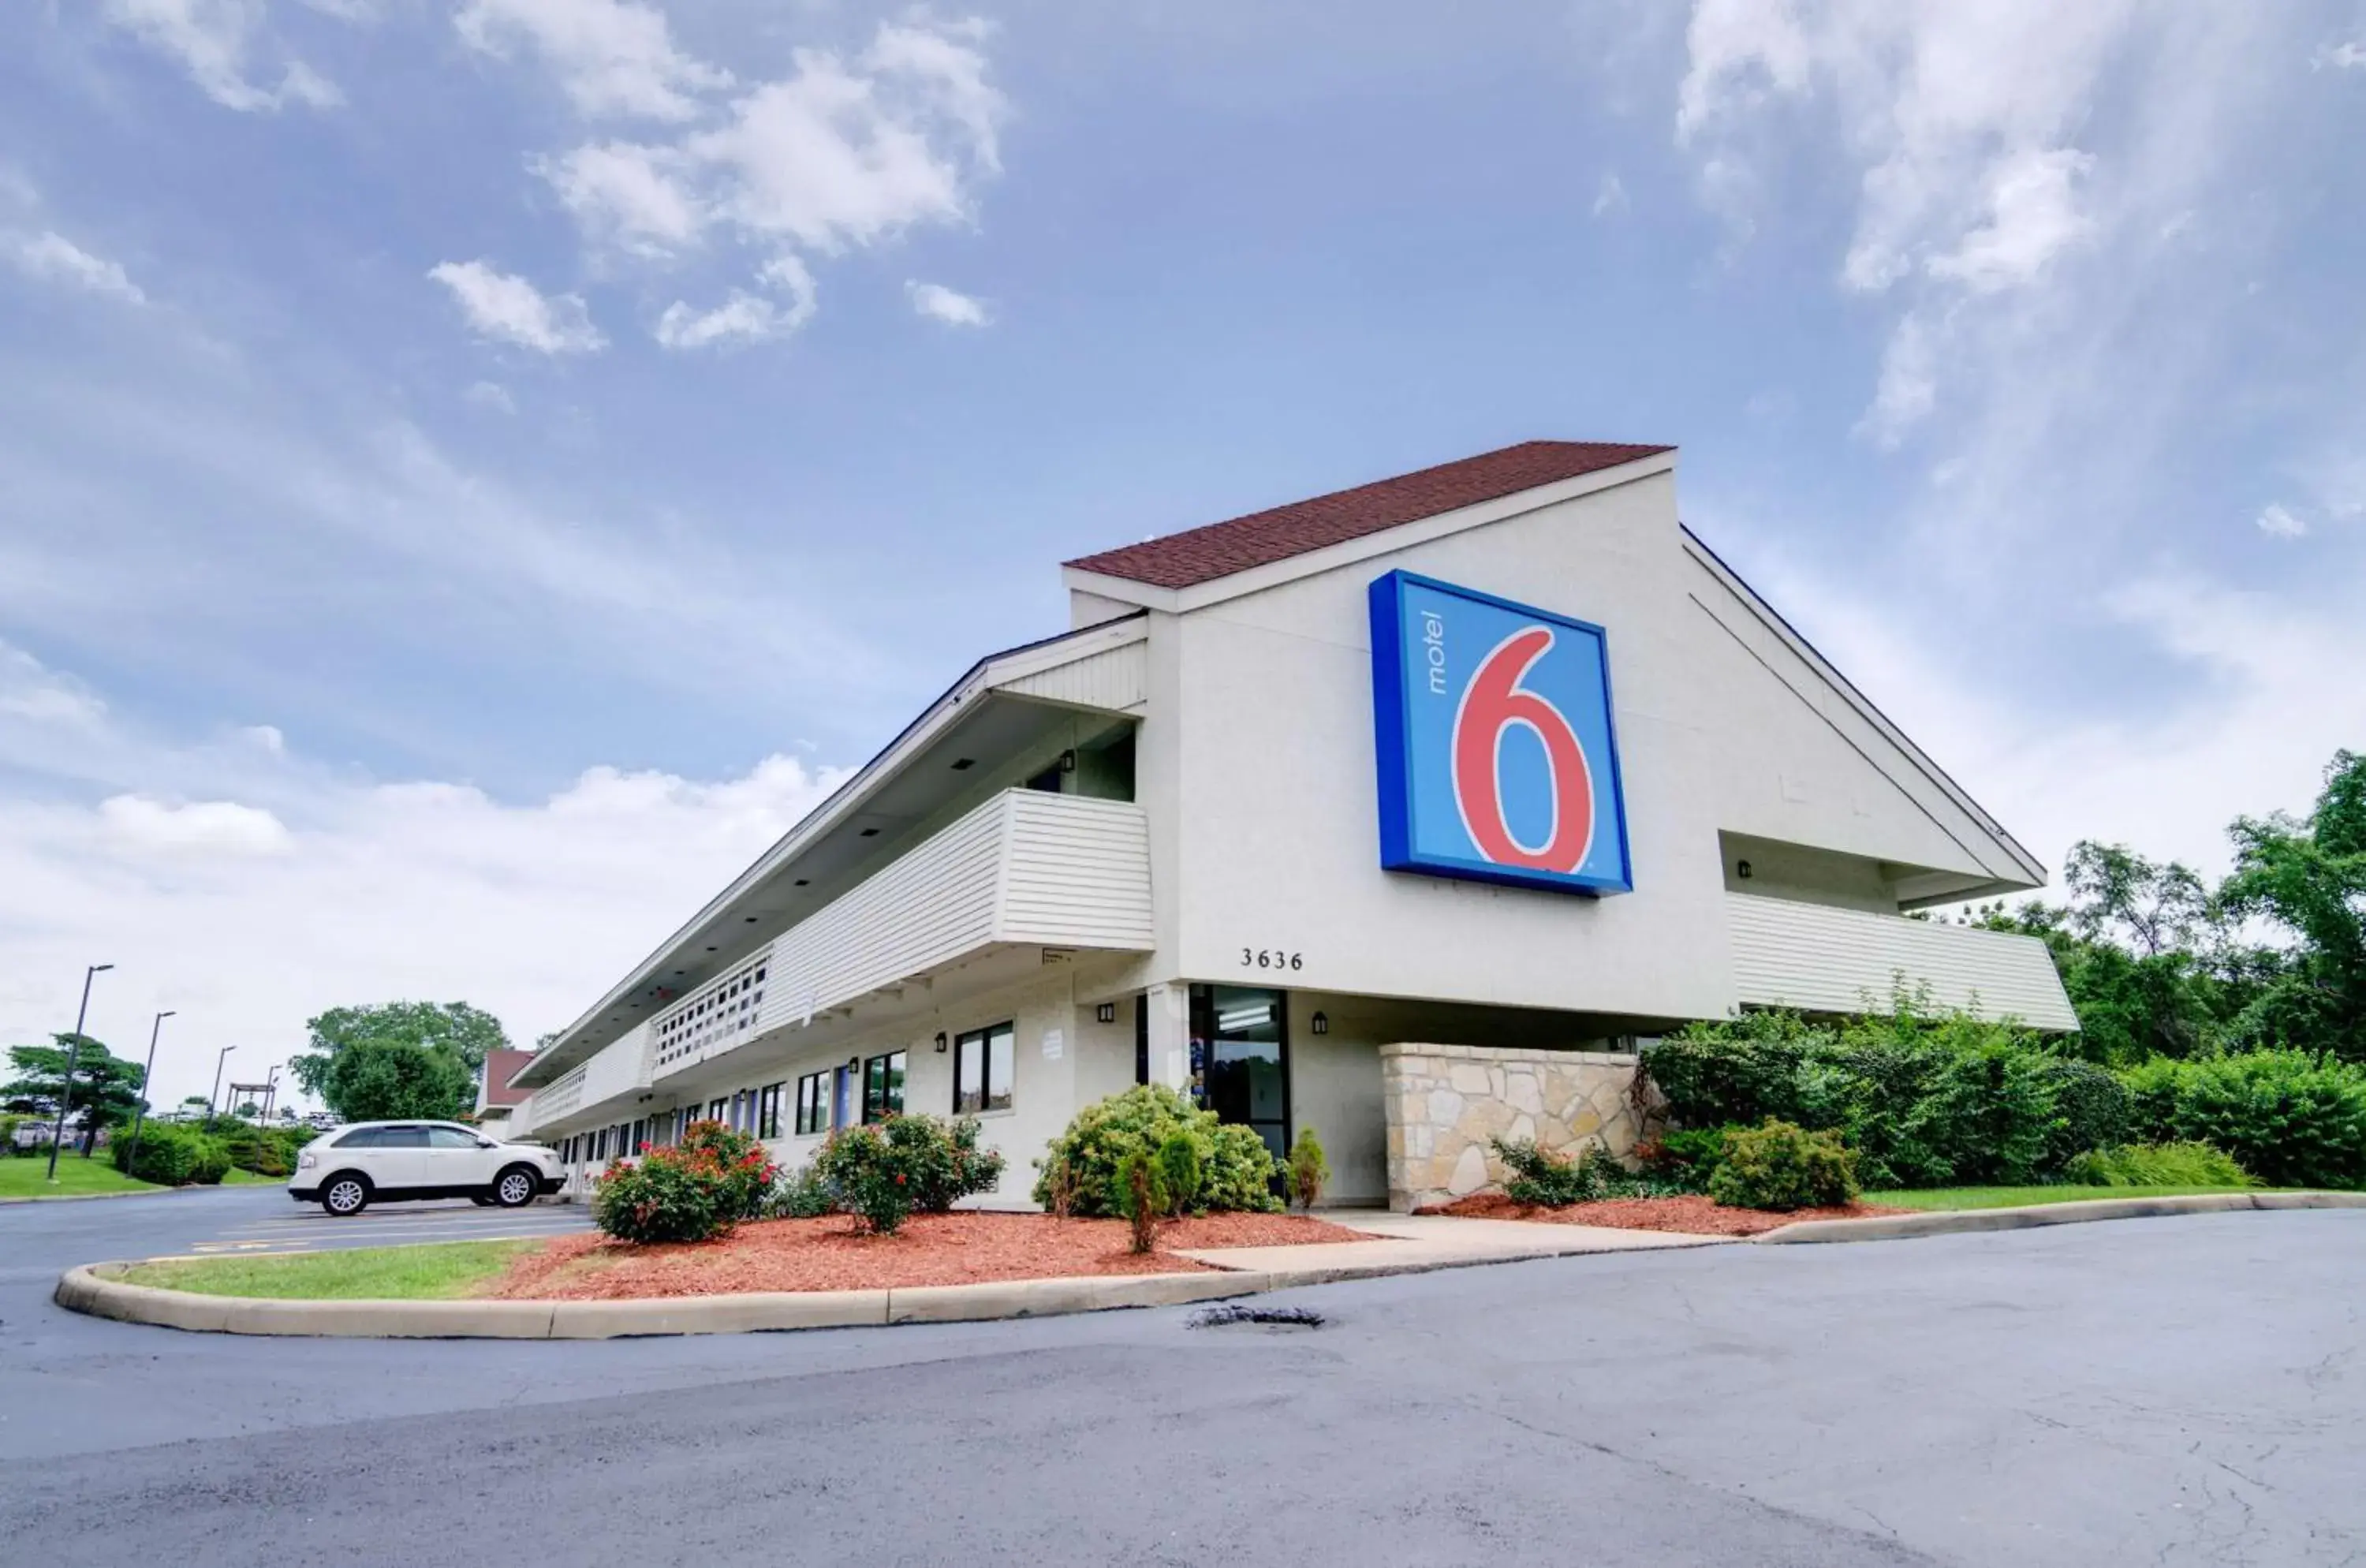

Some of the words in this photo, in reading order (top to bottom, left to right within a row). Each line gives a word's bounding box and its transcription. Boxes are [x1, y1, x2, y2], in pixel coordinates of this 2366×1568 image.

[1420, 610, 1446, 694] motel
[1451, 624, 1595, 873] 6
[1241, 948, 1302, 970] 3636
